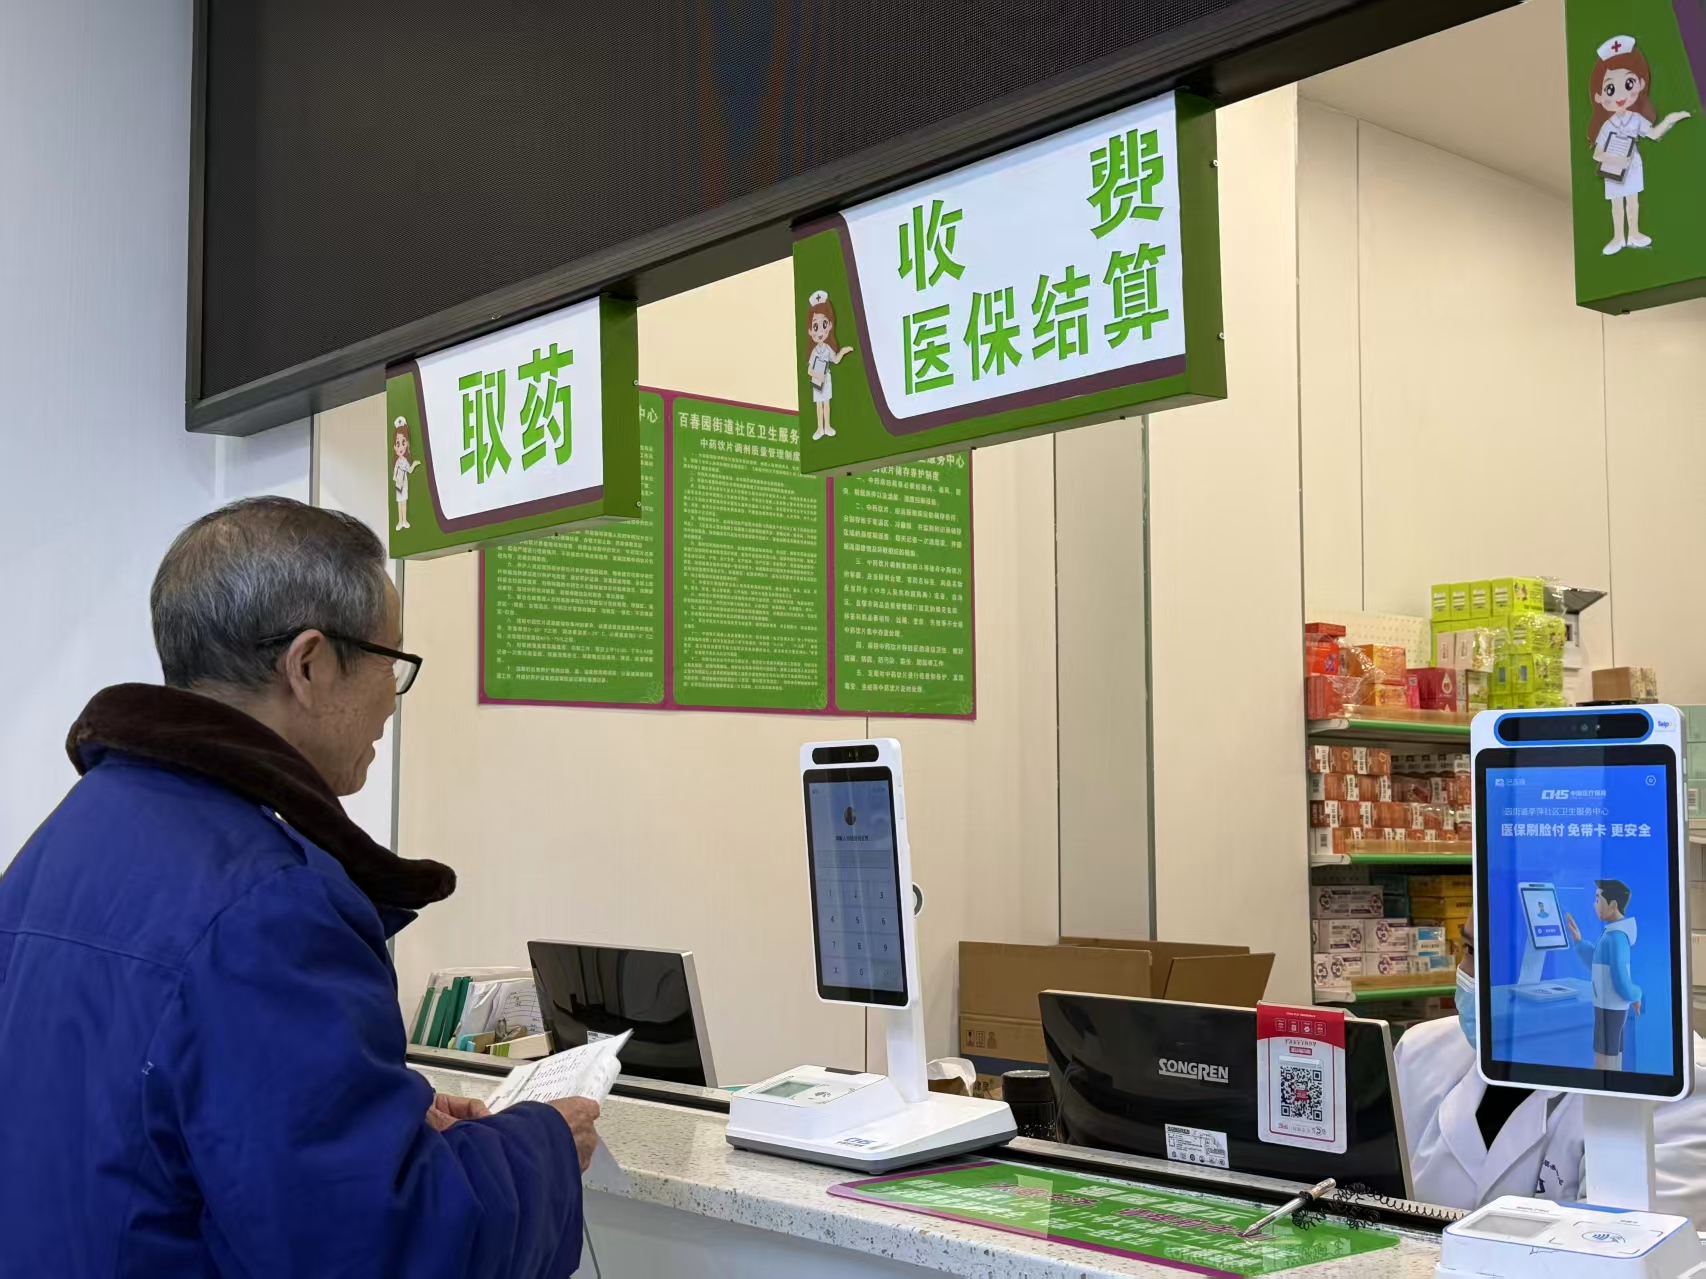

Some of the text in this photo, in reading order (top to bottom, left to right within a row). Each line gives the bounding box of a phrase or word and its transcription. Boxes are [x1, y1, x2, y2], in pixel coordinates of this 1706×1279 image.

[903, 243, 1169, 395] 医保结算
[459, 343, 574, 484] 取药
[1501, 823, 1652, 838] 医保刷脸付 免带卡 更安全
[1158, 1058, 1229, 1083] SONGREN
